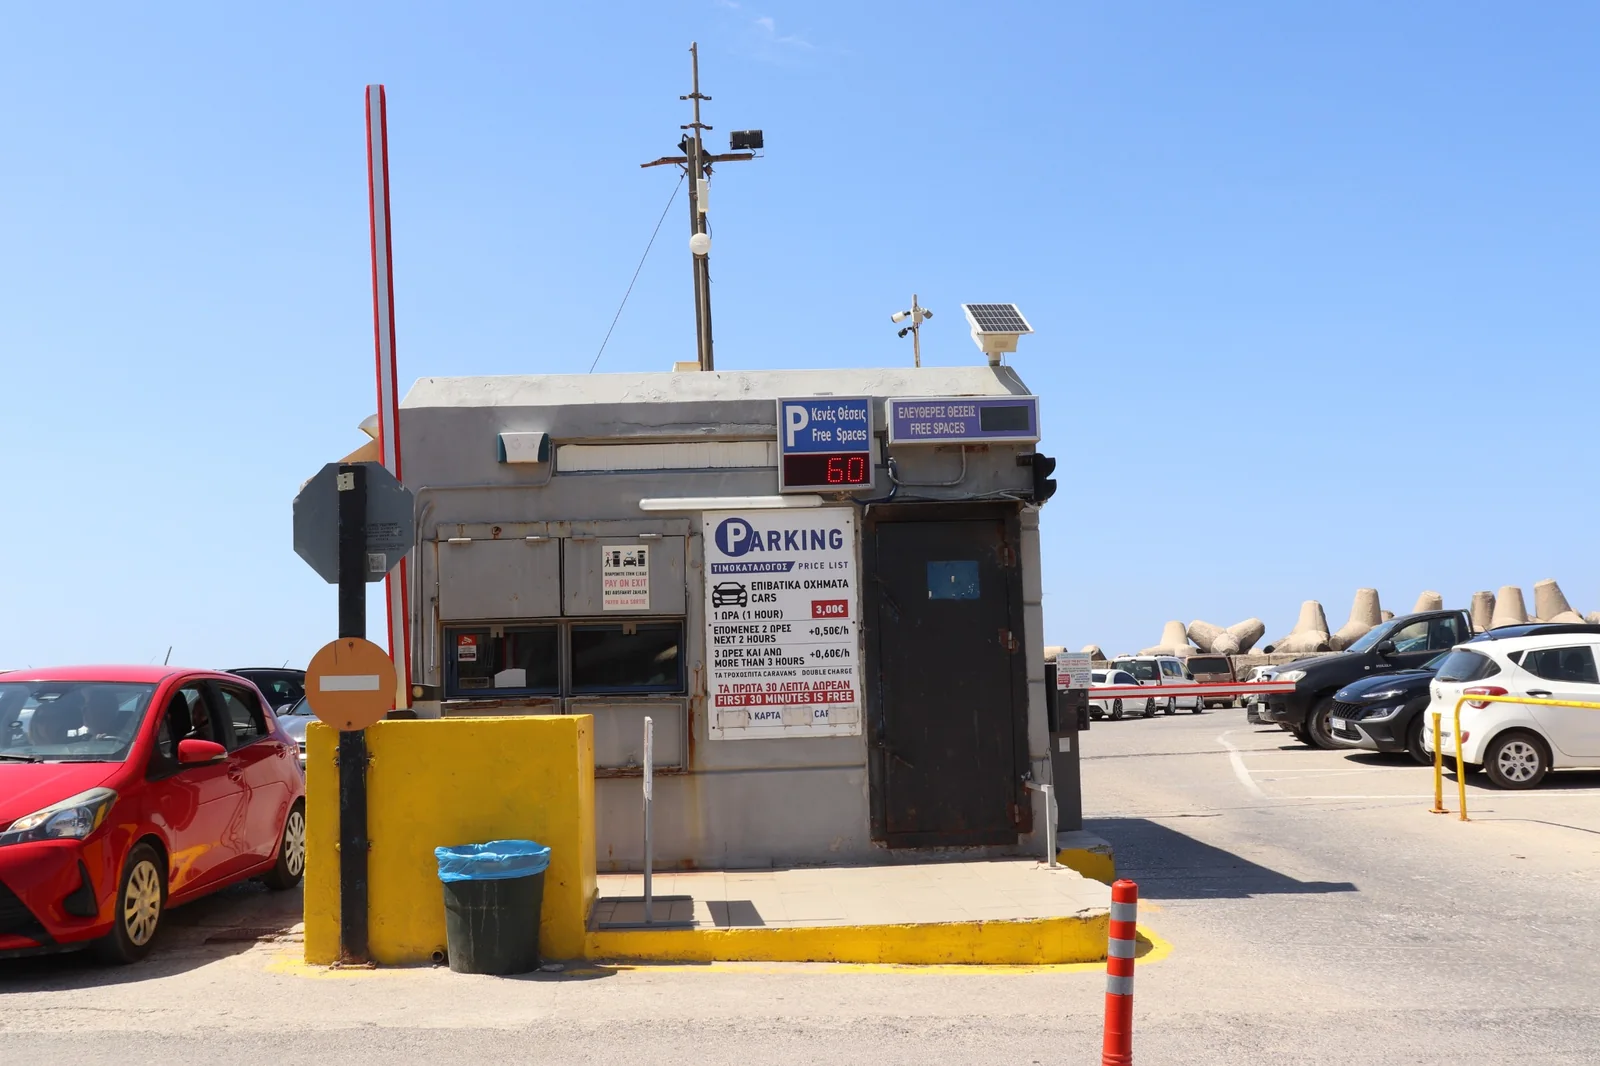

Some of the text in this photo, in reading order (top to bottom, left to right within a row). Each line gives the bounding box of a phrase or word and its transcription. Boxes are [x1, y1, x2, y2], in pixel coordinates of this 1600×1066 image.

[811, 405, 867, 423] Κενές Θέσεις
[898, 405, 976, 419] ΕΛΕΥΘΕΡΕΣ ΘΕΣΕΙΣ
[785, 405, 809, 447] P
[910, 421, 965, 435] FREE SPACES
[812, 428, 867, 444] Free Spaces
[827, 456, 864, 483] 60
[721, 519, 843, 555] PARKING
[713, 562, 788, 573] ΤΙΜΟΚΑΤΑΛΟΓΟΣ
[798, 561, 849, 570] PRICE LIST
[605, 579, 647, 587] PAY ON EXIT
[751, 579, 849, 591] ΕΠΙΒΑΤΙΚΑ ΟΧΗΜΑΤΑ
[751, 593, 777, 603] CARS
[714, 609, 784, 621] 1 ΩΡΑ (1 HOUR)
[815, 605, 844, 616] 3,00€
[714, 624, 792, 635] ΕΠΟΜΕΝΕΣ 2 ΩΡΕΣ
[809, 626, 849, 636] +0,50€/h
[714, 634, 776, 644] NEXT 2 HOURS
[714, 647, 782, 658] 3 ΩΡΕΣ ΚΑΙ ΑΝΩ
[809, 648, 850, 659] +0,60€/h
[714, 656, 805, 668] MORE THAN 3 HOURS
[718, 680, 850, 693] ΤΑ ΠΡΩΤΑ 30 ΛΕΠΤΑ ΔΩΡΕΑΝ
[717, 691, 852, 705] FIRST 30 MINUTES IS FREE
[754, 711, 781, 720] ΚΑΡΤΑ
